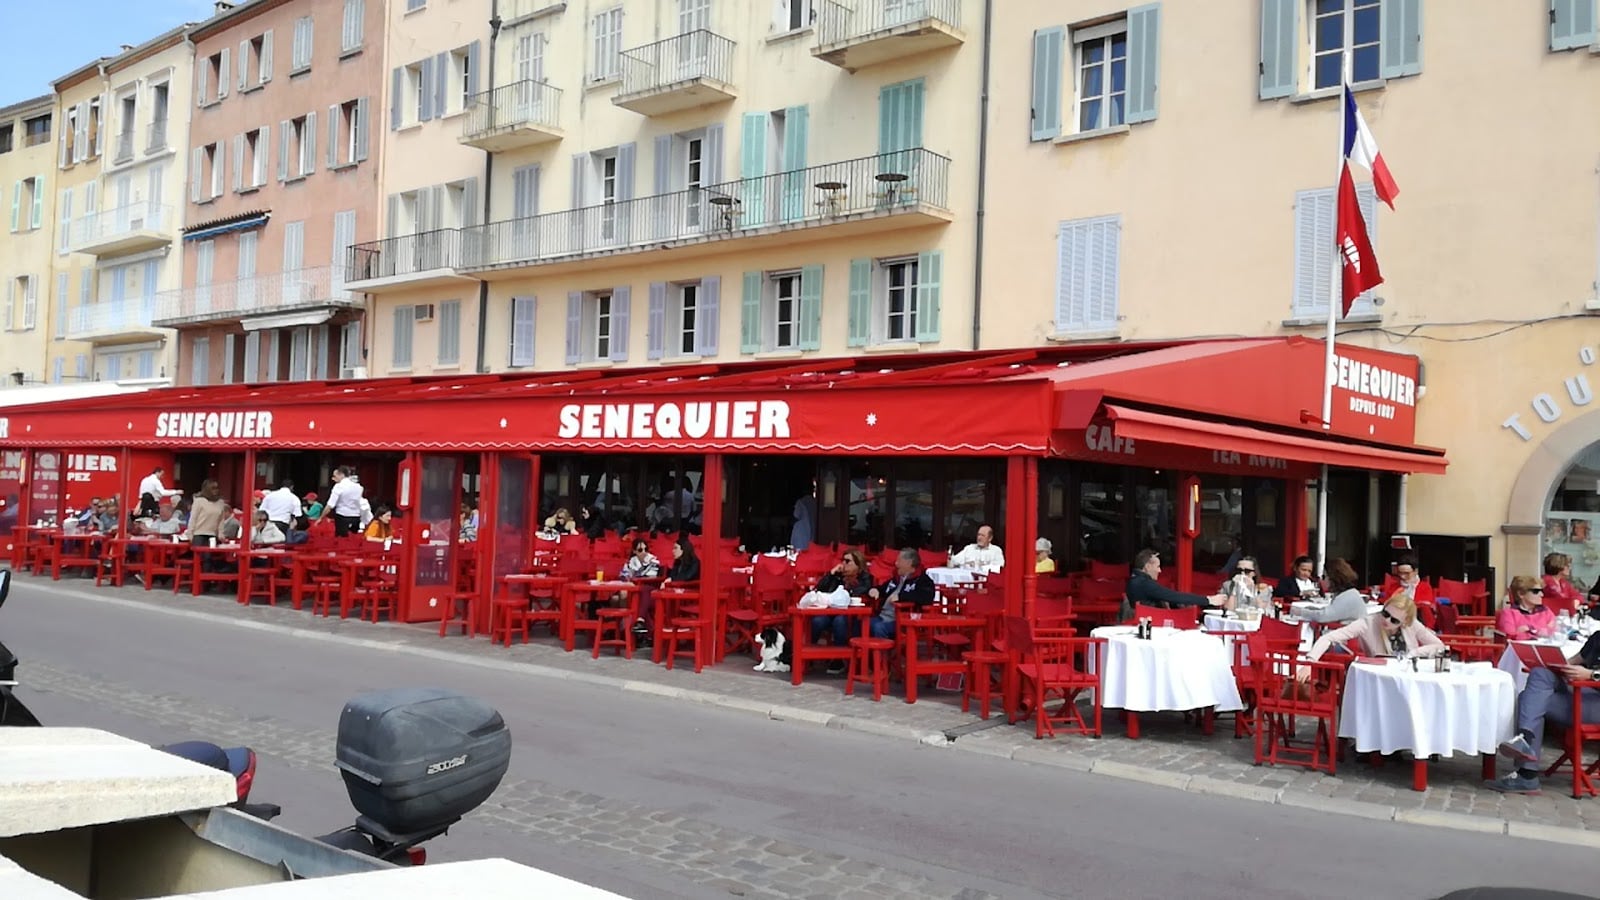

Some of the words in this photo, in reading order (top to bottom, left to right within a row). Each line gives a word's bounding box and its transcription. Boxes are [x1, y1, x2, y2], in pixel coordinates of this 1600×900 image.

[1349, 396, 1377, 416] DEPUIS
[155, 411, 273, 438] SENEQUIER
[558, 400, 791, 440] SENEQUIER
